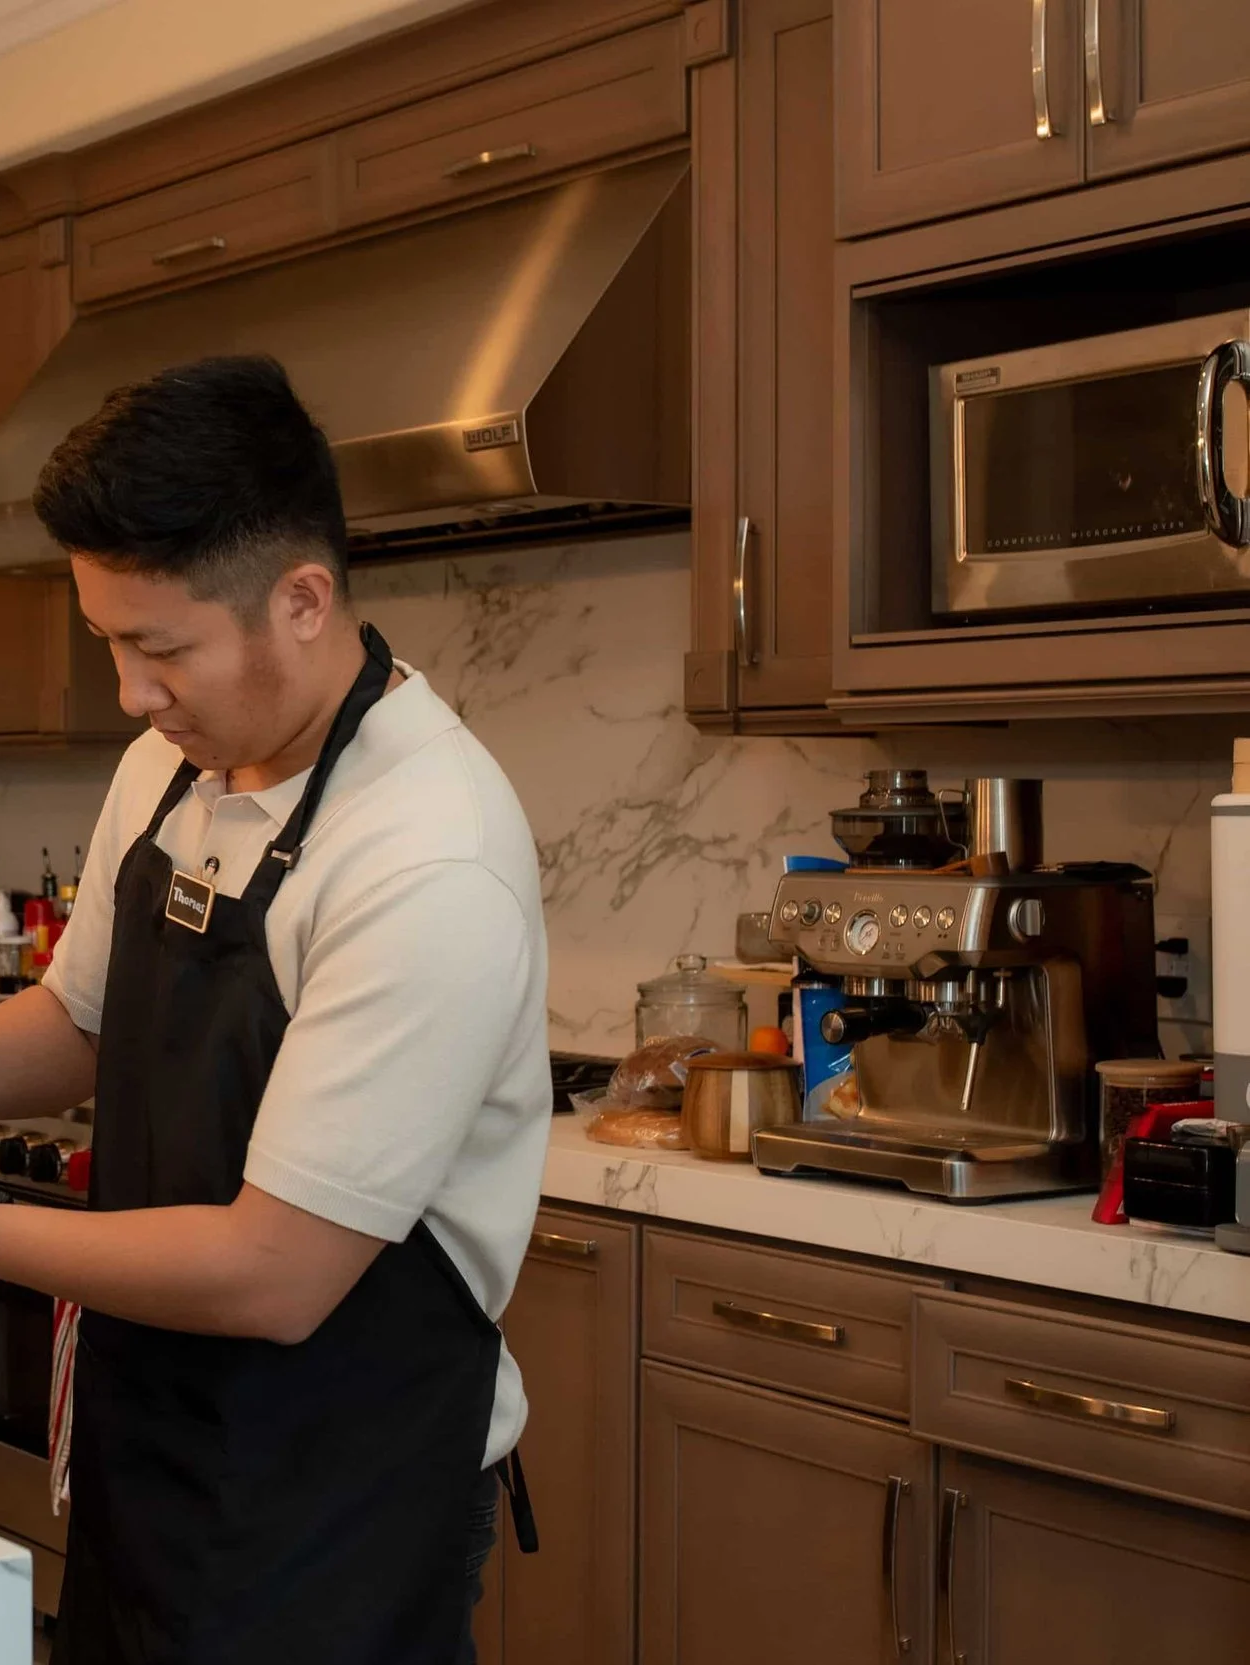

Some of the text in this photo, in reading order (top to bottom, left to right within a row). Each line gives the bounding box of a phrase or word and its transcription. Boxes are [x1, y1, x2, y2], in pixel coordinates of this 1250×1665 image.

[467, 425, 511, 445] WOLF
[987, 521, 1184, 548] COMMERCIAL MICROWAVE OVEN
[173, 886, 206, 914] Thomas
